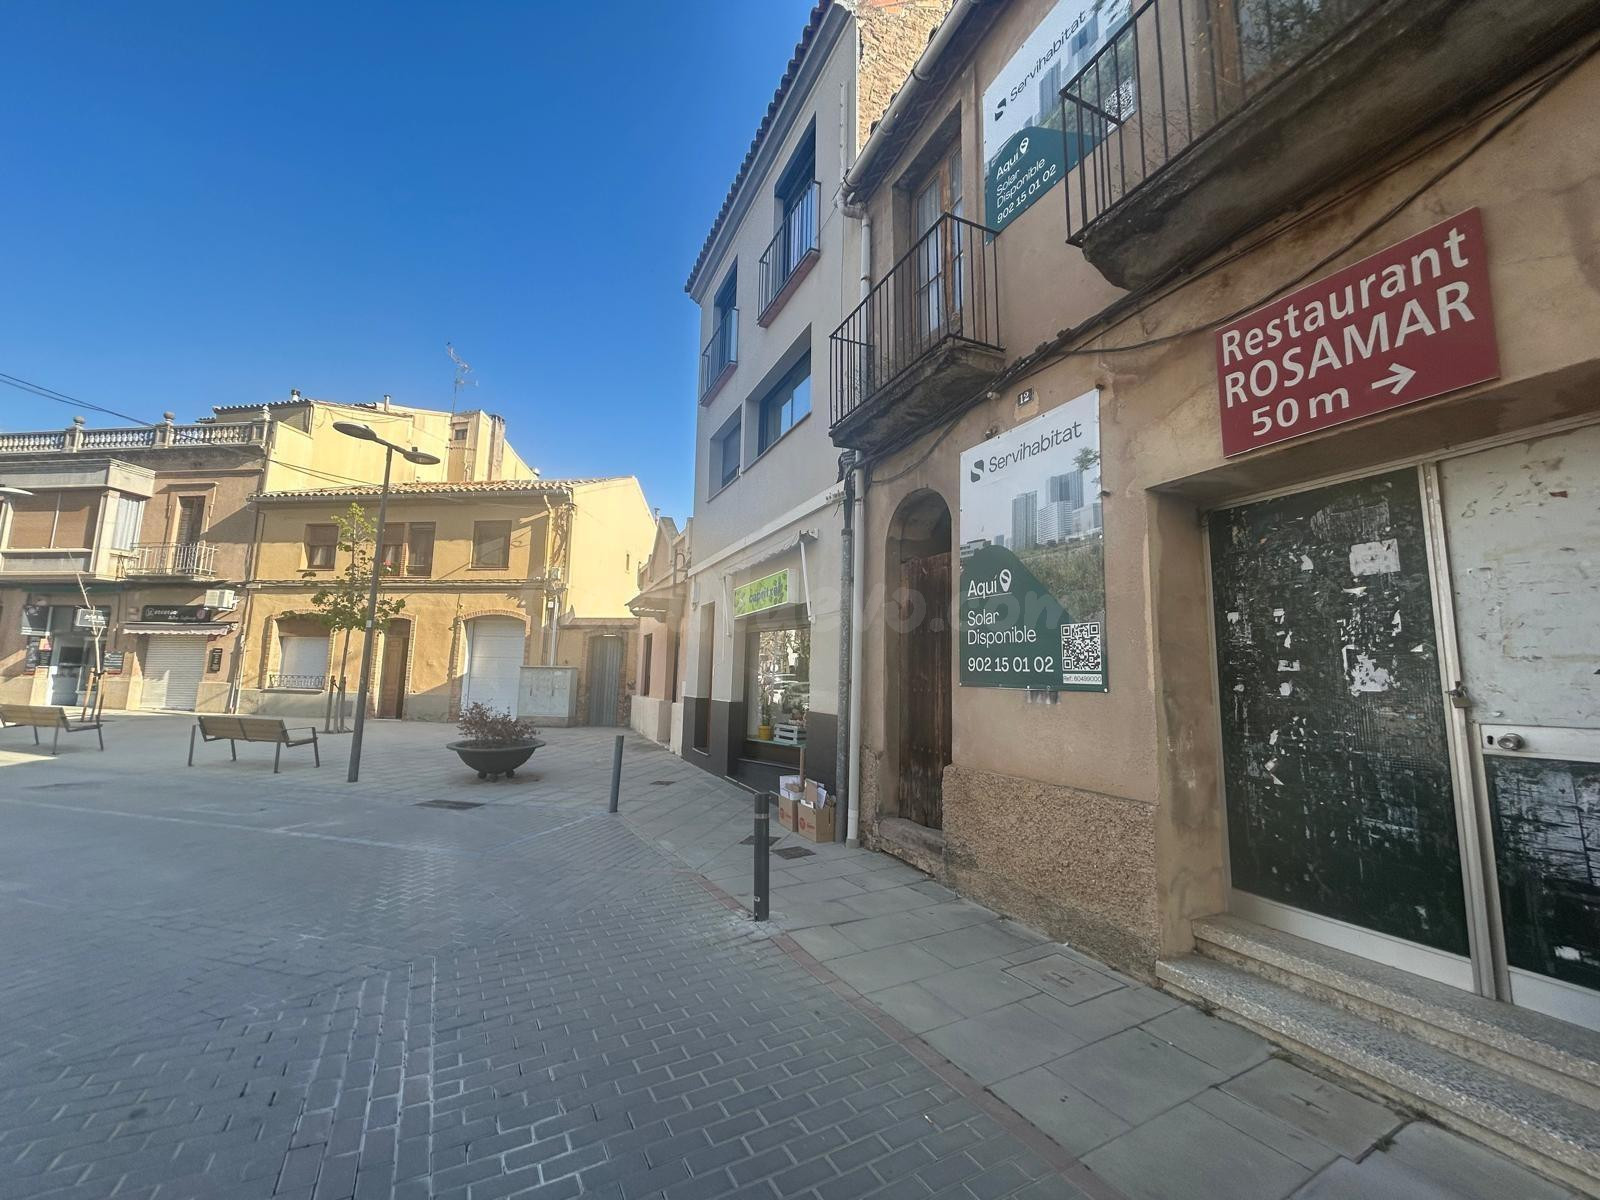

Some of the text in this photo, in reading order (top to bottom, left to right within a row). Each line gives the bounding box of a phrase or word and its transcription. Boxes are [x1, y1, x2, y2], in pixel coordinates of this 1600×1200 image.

[1010, 11, 1086, 102] Servihabitat
[996, 168, 1020, 196] Solar
[996, 158, 1046, 209] Disponible
[997, 164, 1057, 224] 902 15 01 02
[1221, 227, 1469, 367] Restaurant
[1224, 281, 1476, 409] ROSAMAR
[1019, 391, 1030, 405] 12
[1252, 387, 1350, 437] 50 m
[989, 421, 1083, 473] Servihabitat
[967, 575, 998, 599] Aquí
[967, 609, 1000, 627] Solar
[967, 625, 1037, 649] Disponible
[967, 656, 1055, 672] 902 15 01 02
